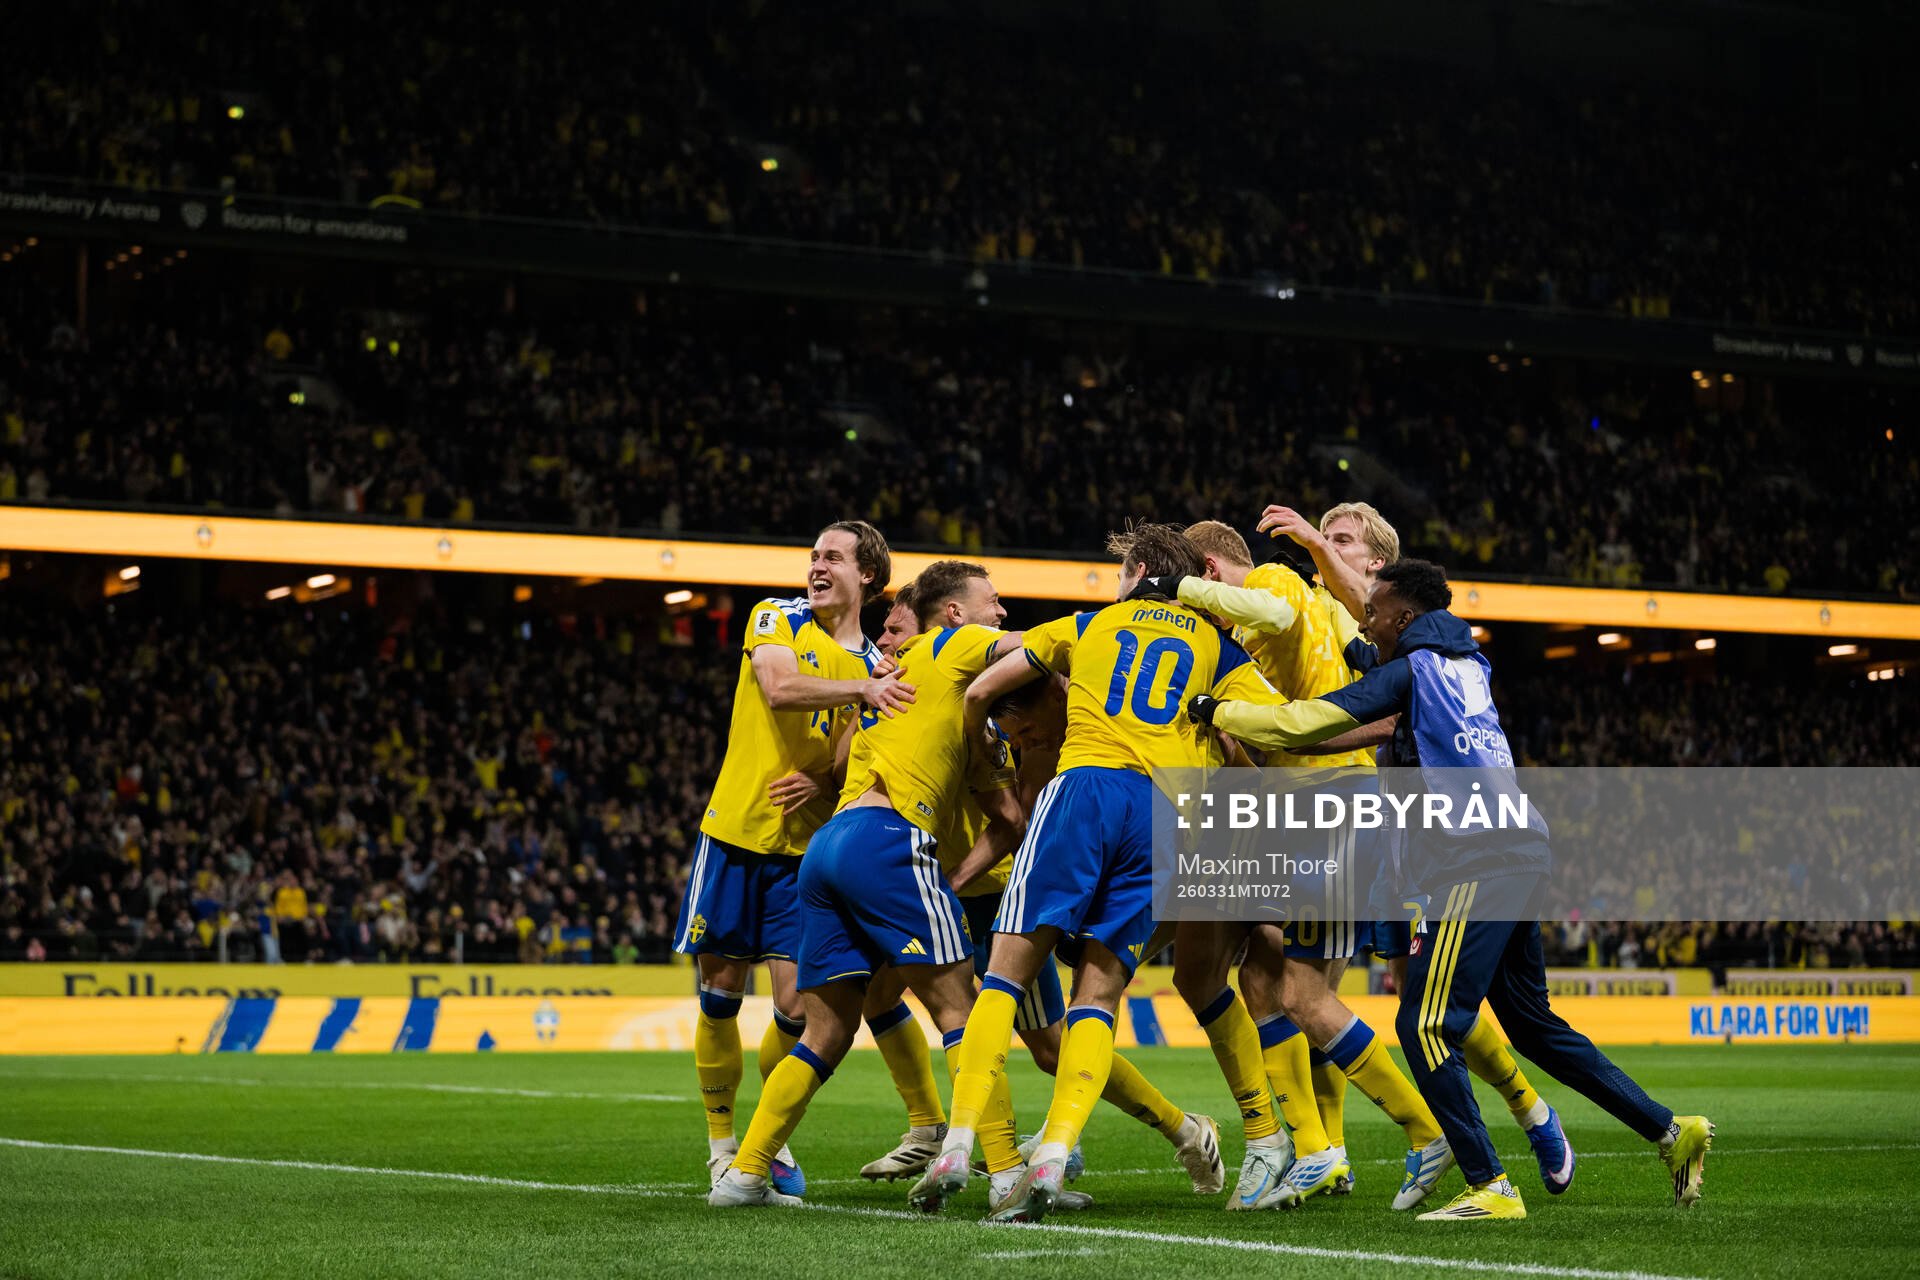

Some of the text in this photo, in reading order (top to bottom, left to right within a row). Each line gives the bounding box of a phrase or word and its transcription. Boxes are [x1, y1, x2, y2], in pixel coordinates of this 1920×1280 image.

[99, 196, 160, 222] Arena
[222, 206, 407, 242] Room for emotions
[1132, 608, 1197, 634] NYGREN
[1105, 629, 1194, 725] 10
[1691, 1004, 1869, 1036] KLARA FÖR VM!
